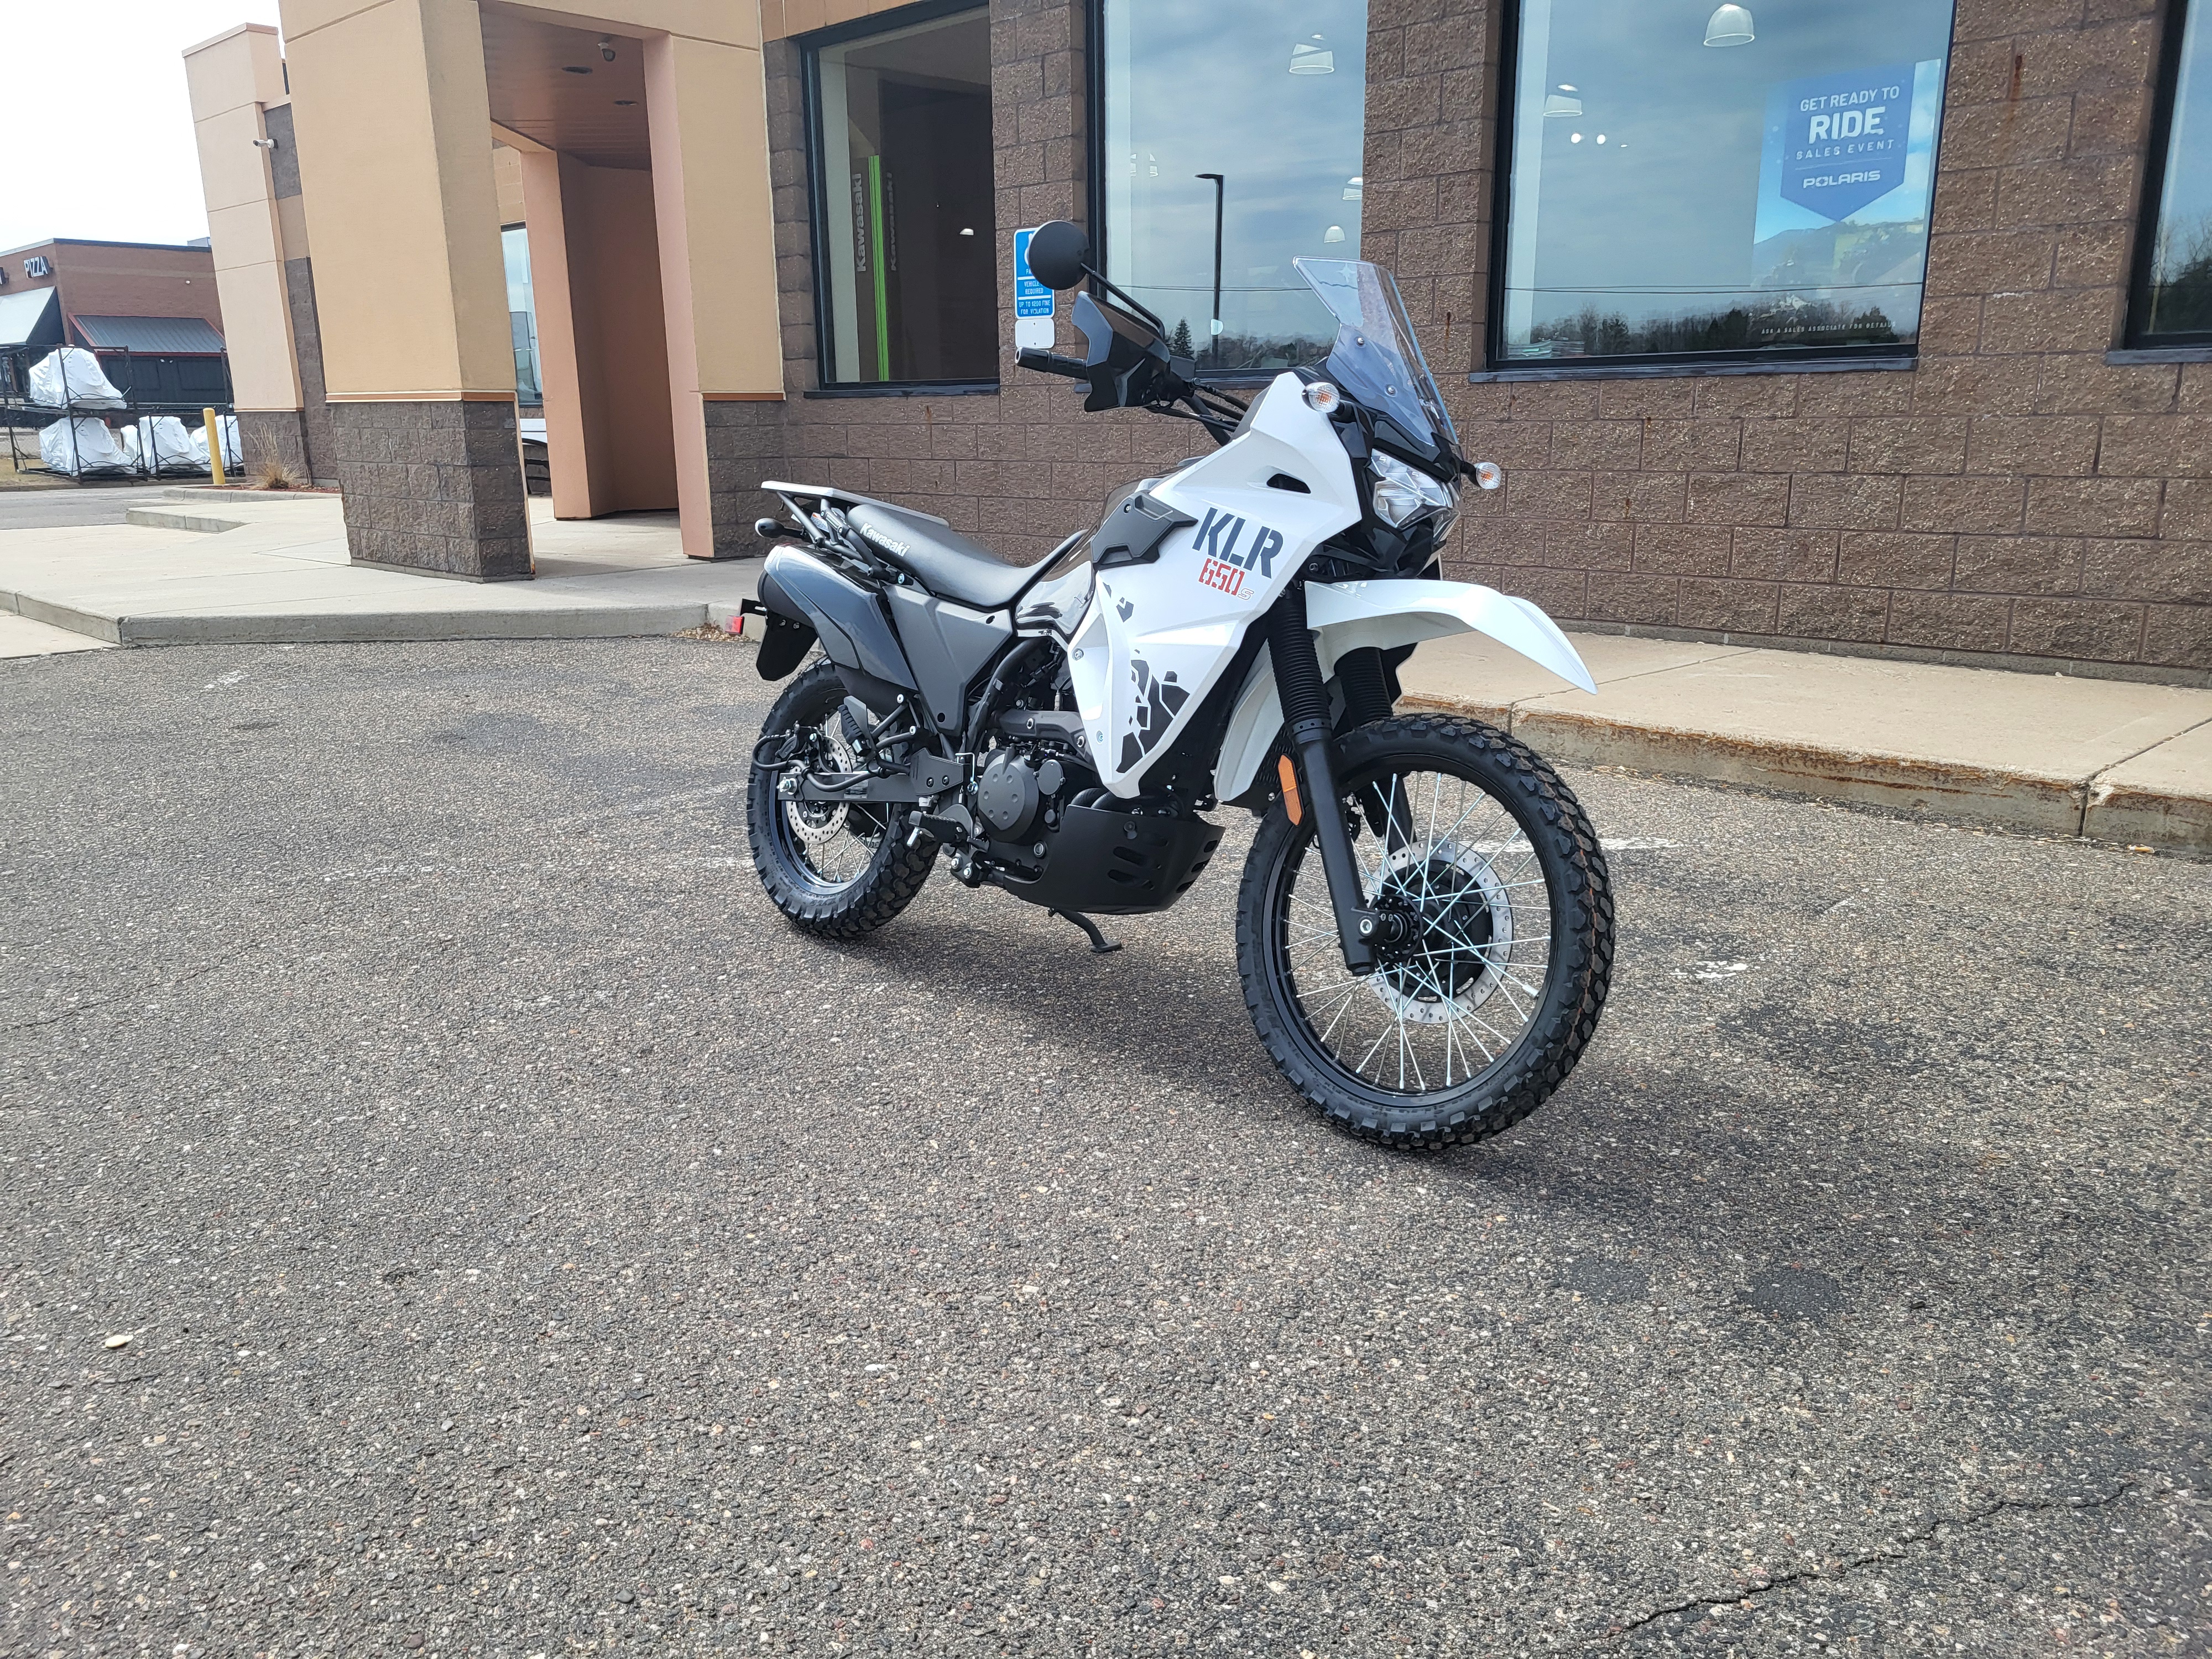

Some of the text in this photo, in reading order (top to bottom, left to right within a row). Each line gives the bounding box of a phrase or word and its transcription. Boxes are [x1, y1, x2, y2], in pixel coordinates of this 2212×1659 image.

[1800, 86, 1900, 112] GET READY TO
[1809, 106, 1886, 144] RIDE
[1796, 139, 1894, 160] SALES EVENT
[1803, 170, 1880, 189] POLARIS
[852, 173, 866, 272] Kawasaki
[24, 256, 48, 278] PIZZA
[859, 522, 911, 557] Kawasaki
[1192, 507, 1284, 580] KLR
[1198, 557, 1245, 596] 650
